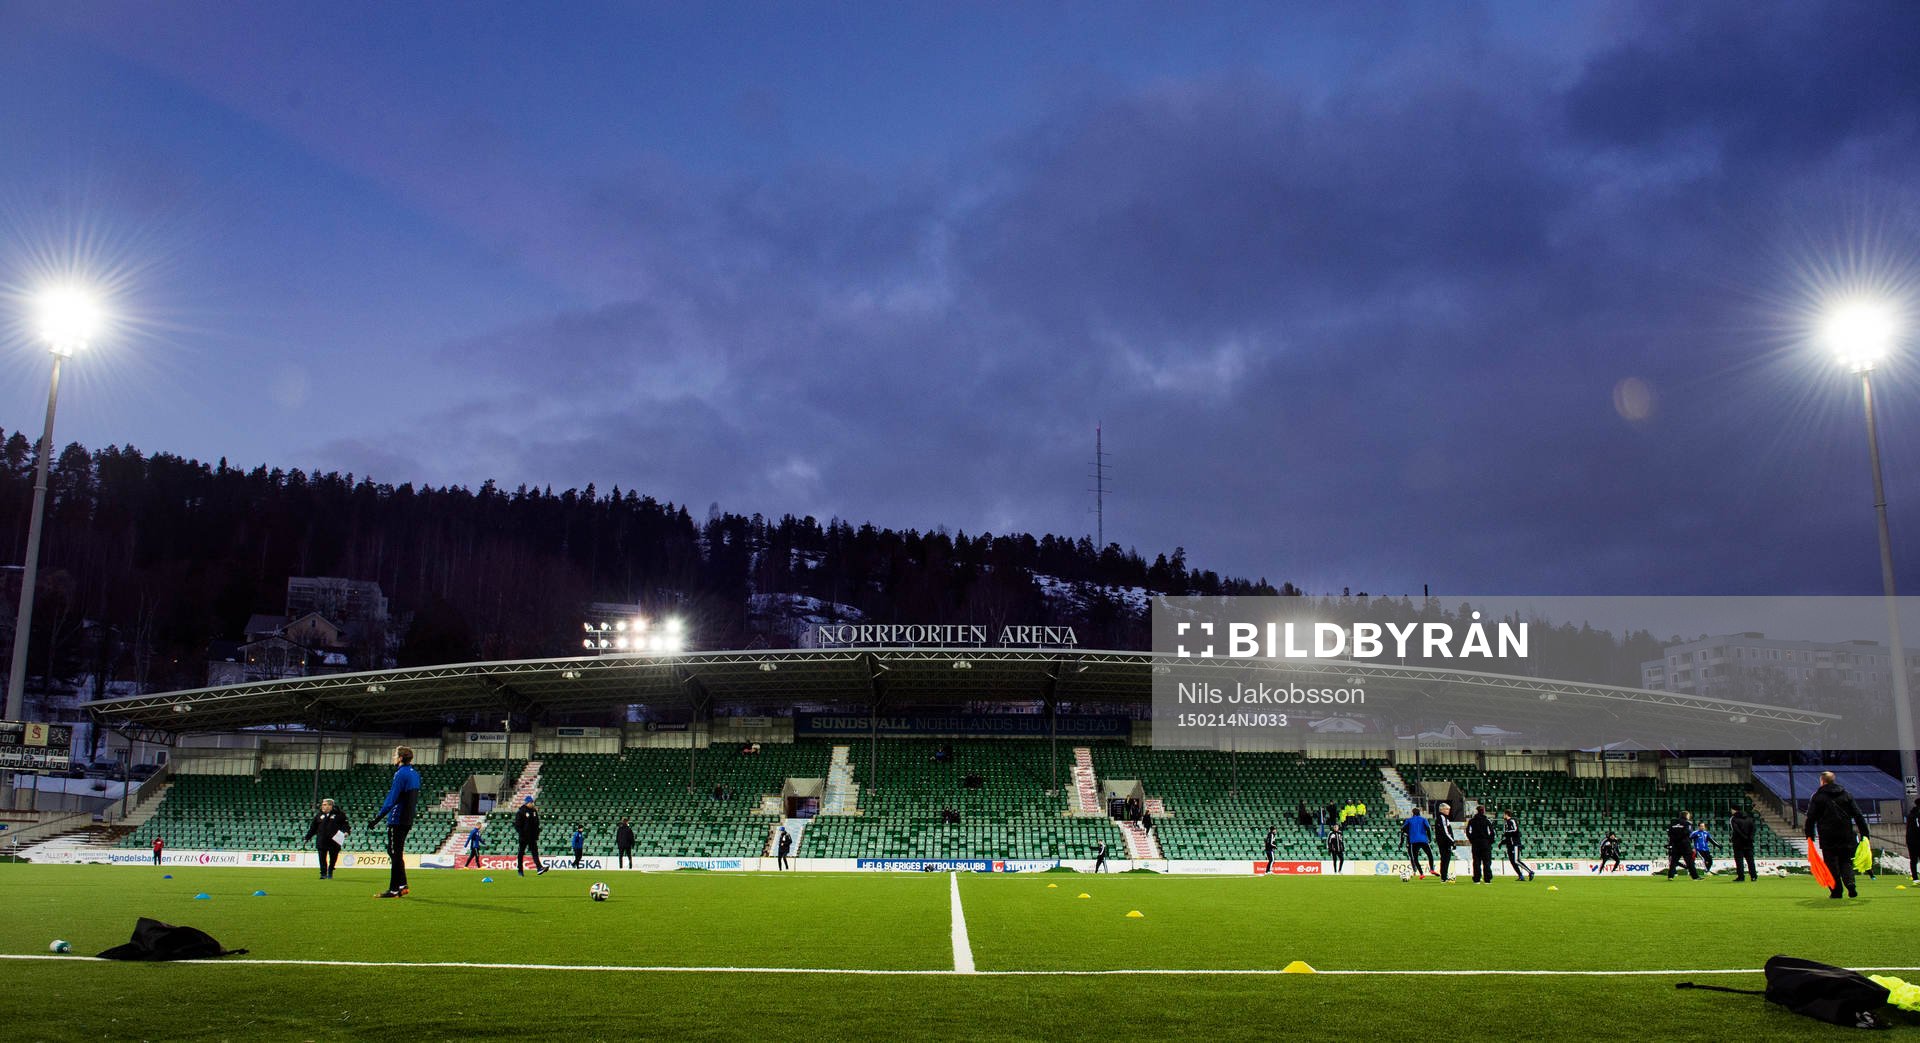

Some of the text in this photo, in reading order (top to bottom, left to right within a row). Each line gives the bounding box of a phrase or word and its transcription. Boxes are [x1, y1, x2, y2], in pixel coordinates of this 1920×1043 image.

[818, 624, 1078, 644] NORRPORTEN ARENA
[811, 717, 911, 729] SUNDSVALL
[915, 718, 1013, 730] NORRLANDS
[1906, 776, 1915, 784] WC
[252, 854, 290, 862] PEAB
[1536, 862, 1574, 871] PEAB
